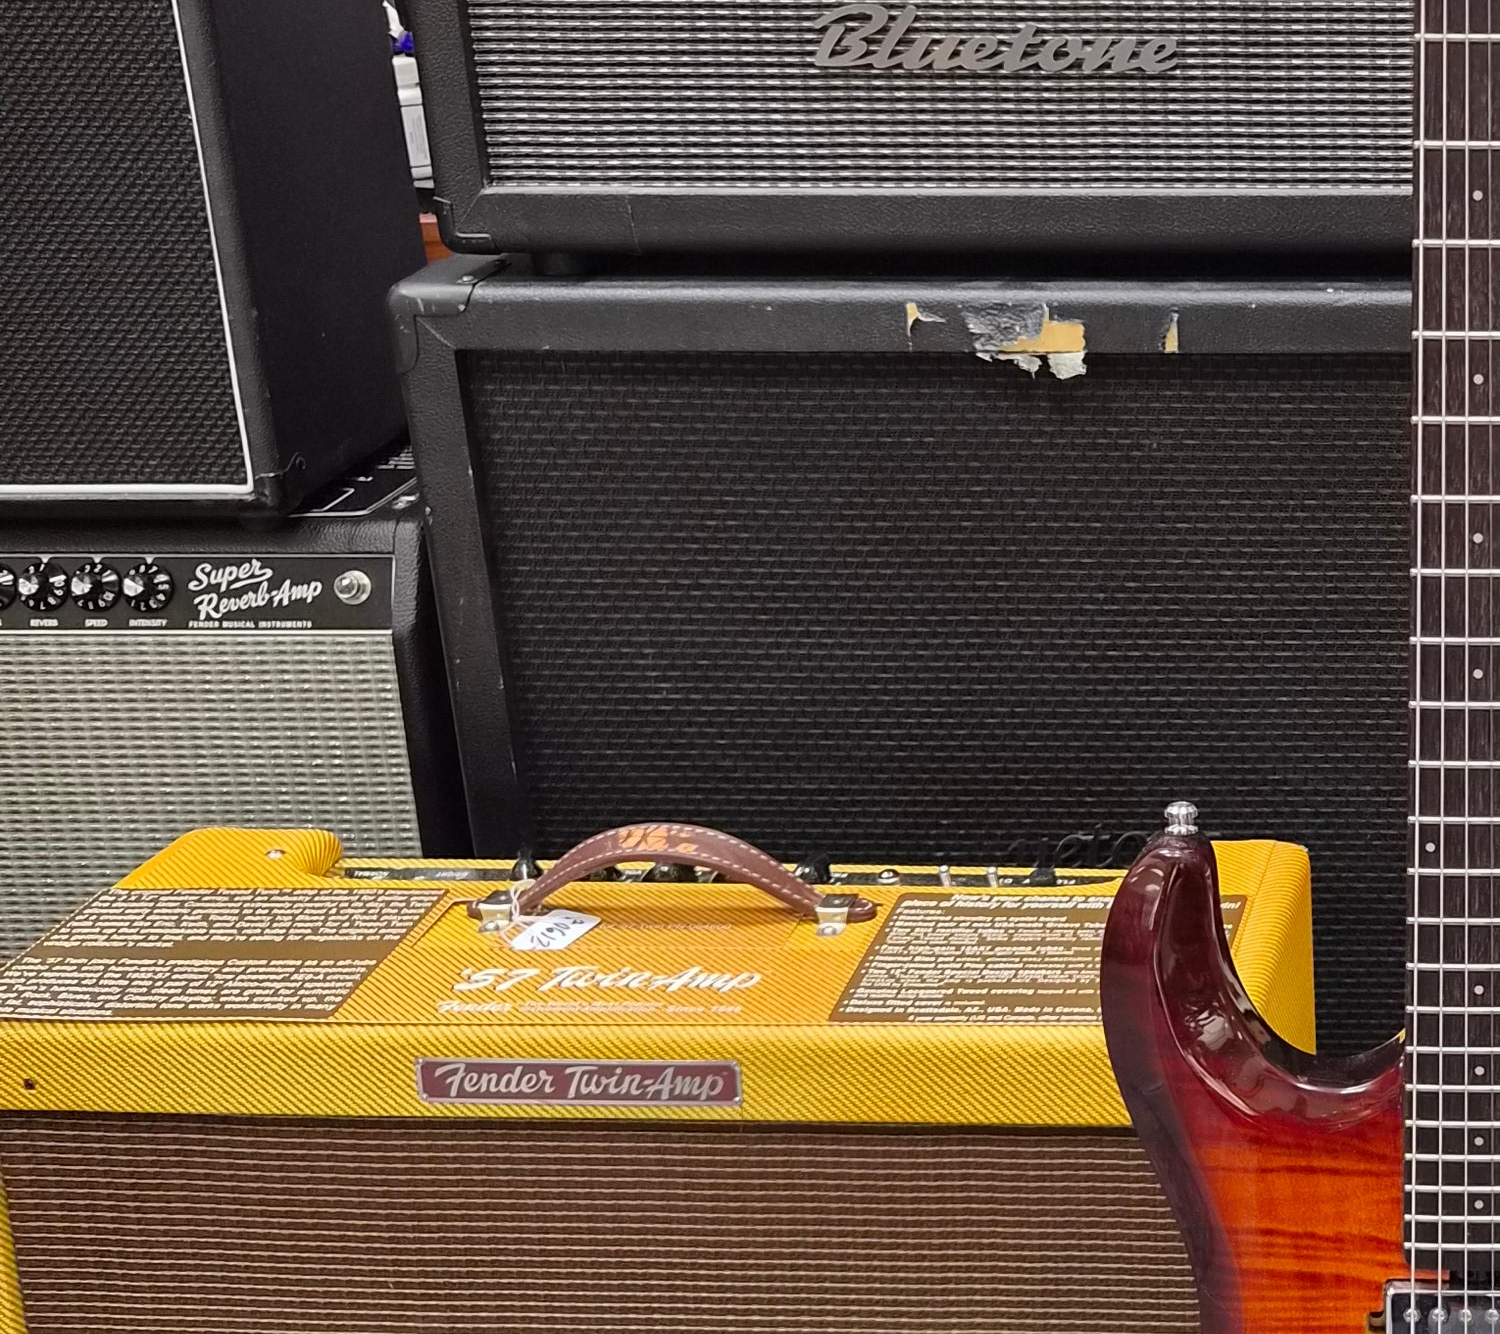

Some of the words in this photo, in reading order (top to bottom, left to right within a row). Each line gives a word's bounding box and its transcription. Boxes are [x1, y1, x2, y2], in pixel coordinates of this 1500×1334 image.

[813, 3, 1179, 73] Bluetone
[188, 558, 274, 591] Super
[194, 579, 322, 620] Reverb-Amp
[435, 1063, 556, 1097] Fender
[563, 1066, 724, 1101] Twin-Amp
